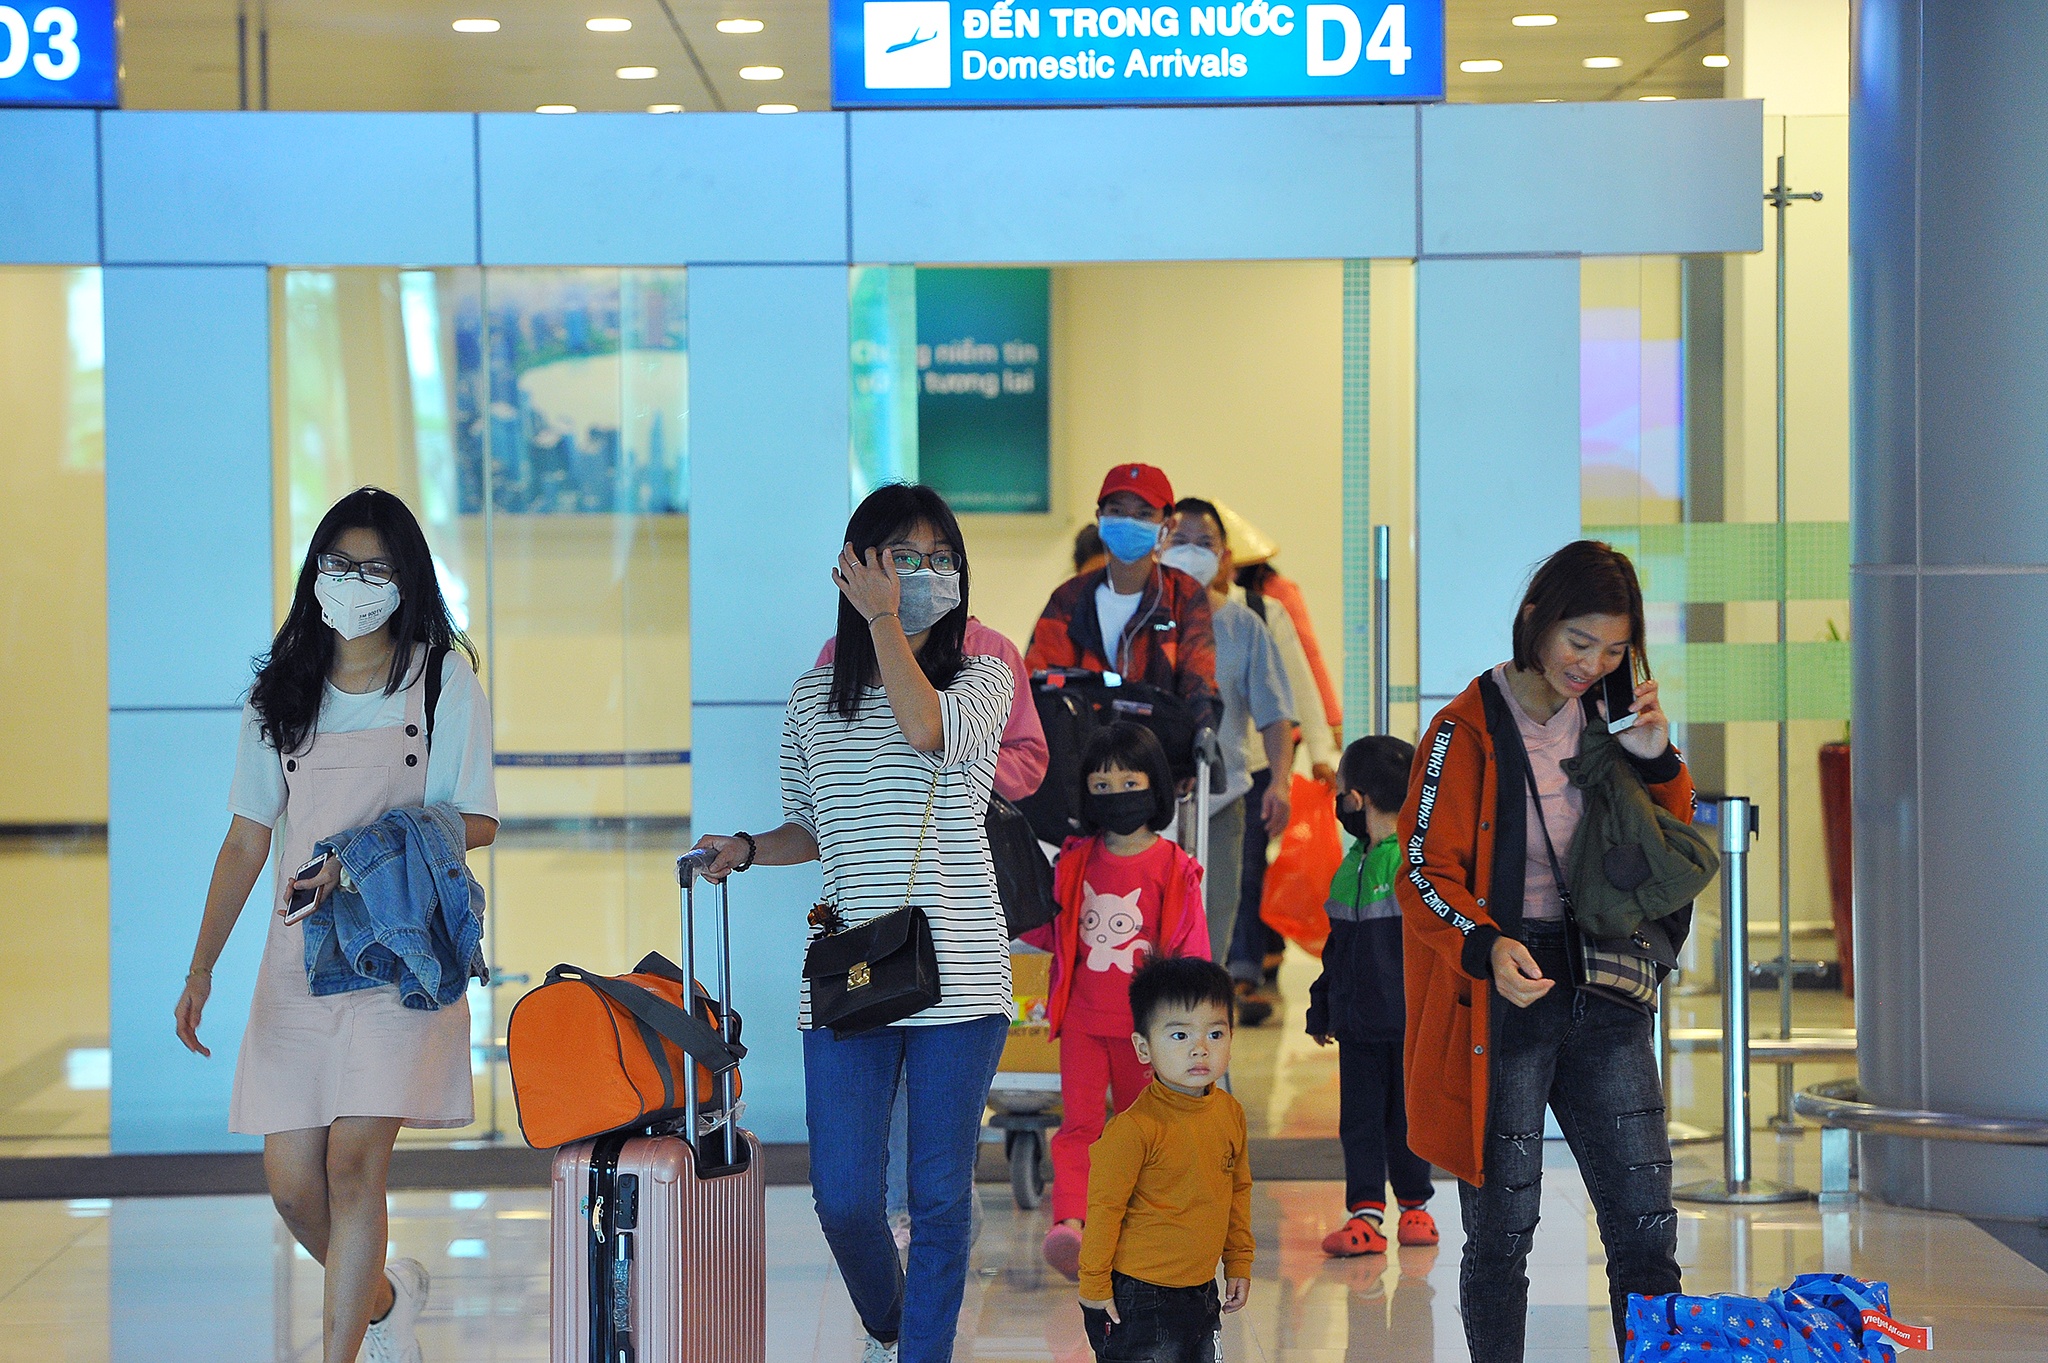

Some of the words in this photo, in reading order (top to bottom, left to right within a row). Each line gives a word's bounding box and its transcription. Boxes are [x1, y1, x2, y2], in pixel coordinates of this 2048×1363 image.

[962, 0, 1040, 38] ĐẾN
[1049, 6, 1180, 38] TRONG
[1190, 0, 1295, 37] NƯỚC
[1306, 4, 1413, 77] D4
[0, 5, 80, 81] D3
[962, 49, 1116, 80] Domestic
[1123, 47, 1249, 78] Arrivals
[1426, 732, 1451, 778] CHANEL
[1418, 784, 1437, 829] CHANEL
